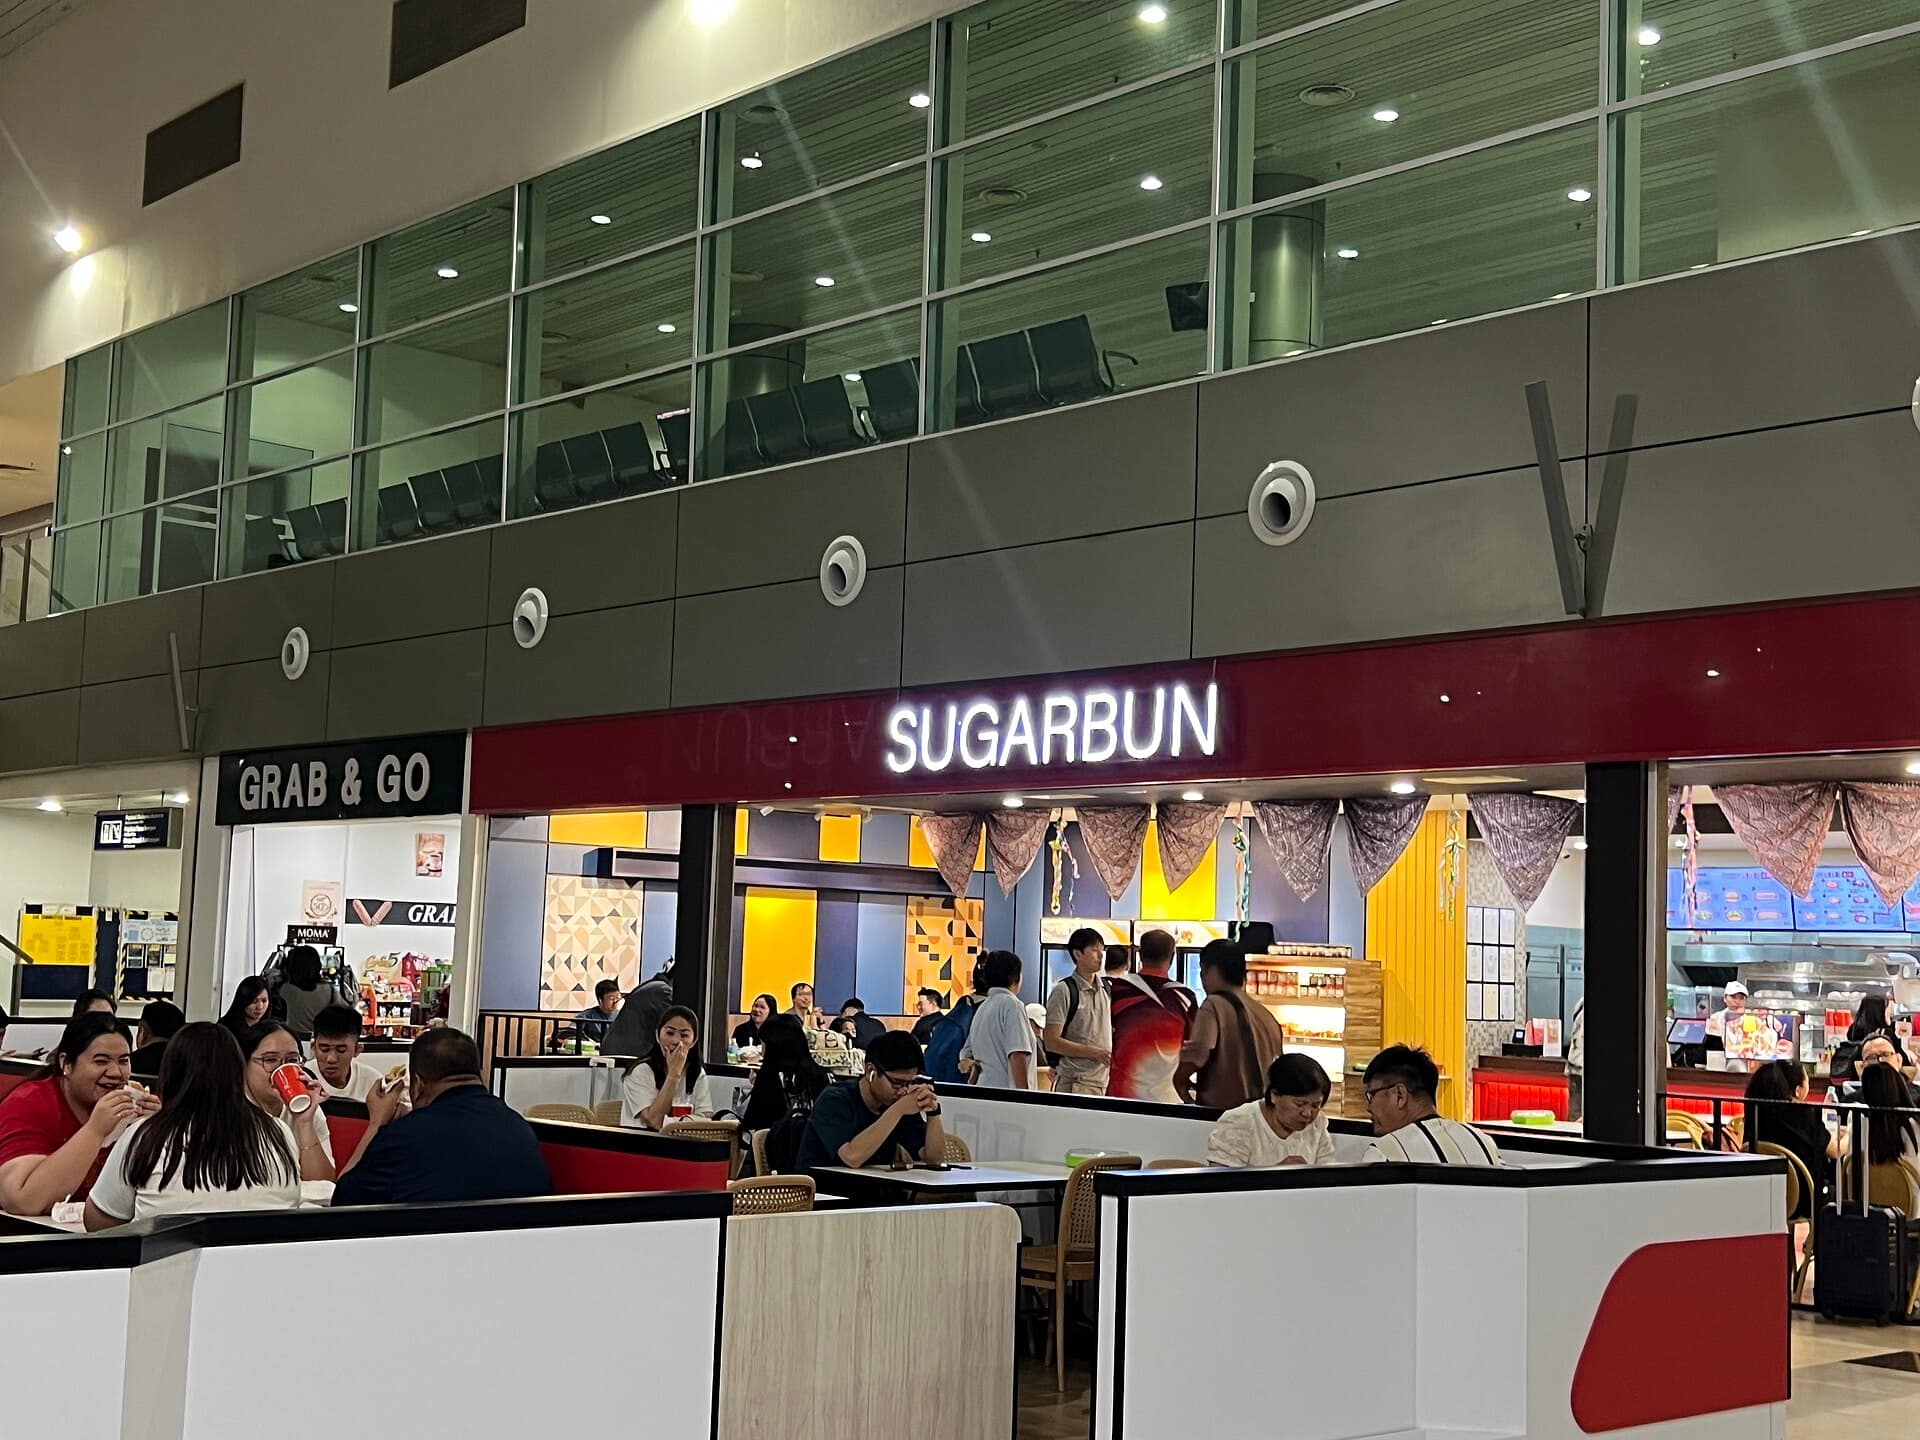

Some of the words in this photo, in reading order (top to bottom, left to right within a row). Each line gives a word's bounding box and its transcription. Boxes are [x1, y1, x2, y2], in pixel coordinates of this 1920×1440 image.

[887, 683, 1218, 773] SUGARBUN
[239, 761, 327, 811] GRAB
[341, 757, 362, 807] &
[376, 752, 431, 804] GO
